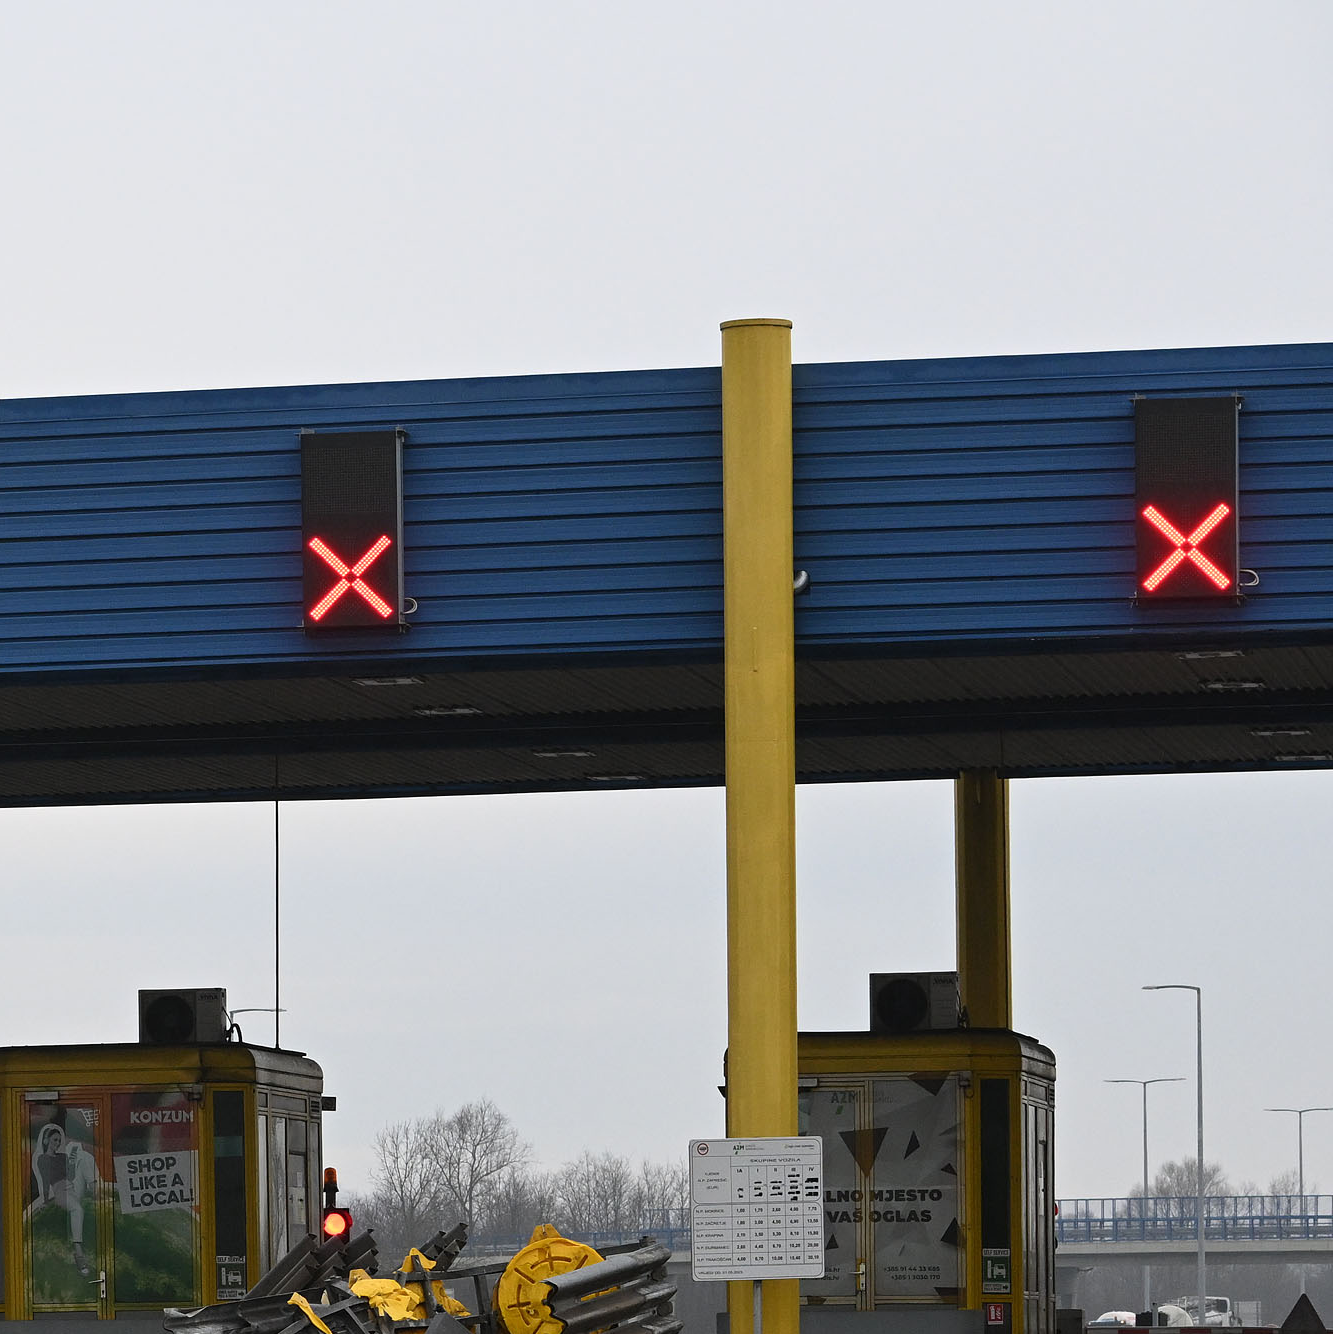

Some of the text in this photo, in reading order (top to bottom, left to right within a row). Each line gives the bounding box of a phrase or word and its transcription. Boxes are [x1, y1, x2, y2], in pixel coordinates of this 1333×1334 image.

[130, 1110, 193, 1124] KONZUM
[127, 1156, 176, 1174] SHOP
[129, 1173, 184, 1191] LIKE A
[130, 1188, 194, 1208] LOCAL!
[823, 1189, 942, 1202] LNO MJESTO
[826, 1207, 932, 1223] VAŠ OGLAS
